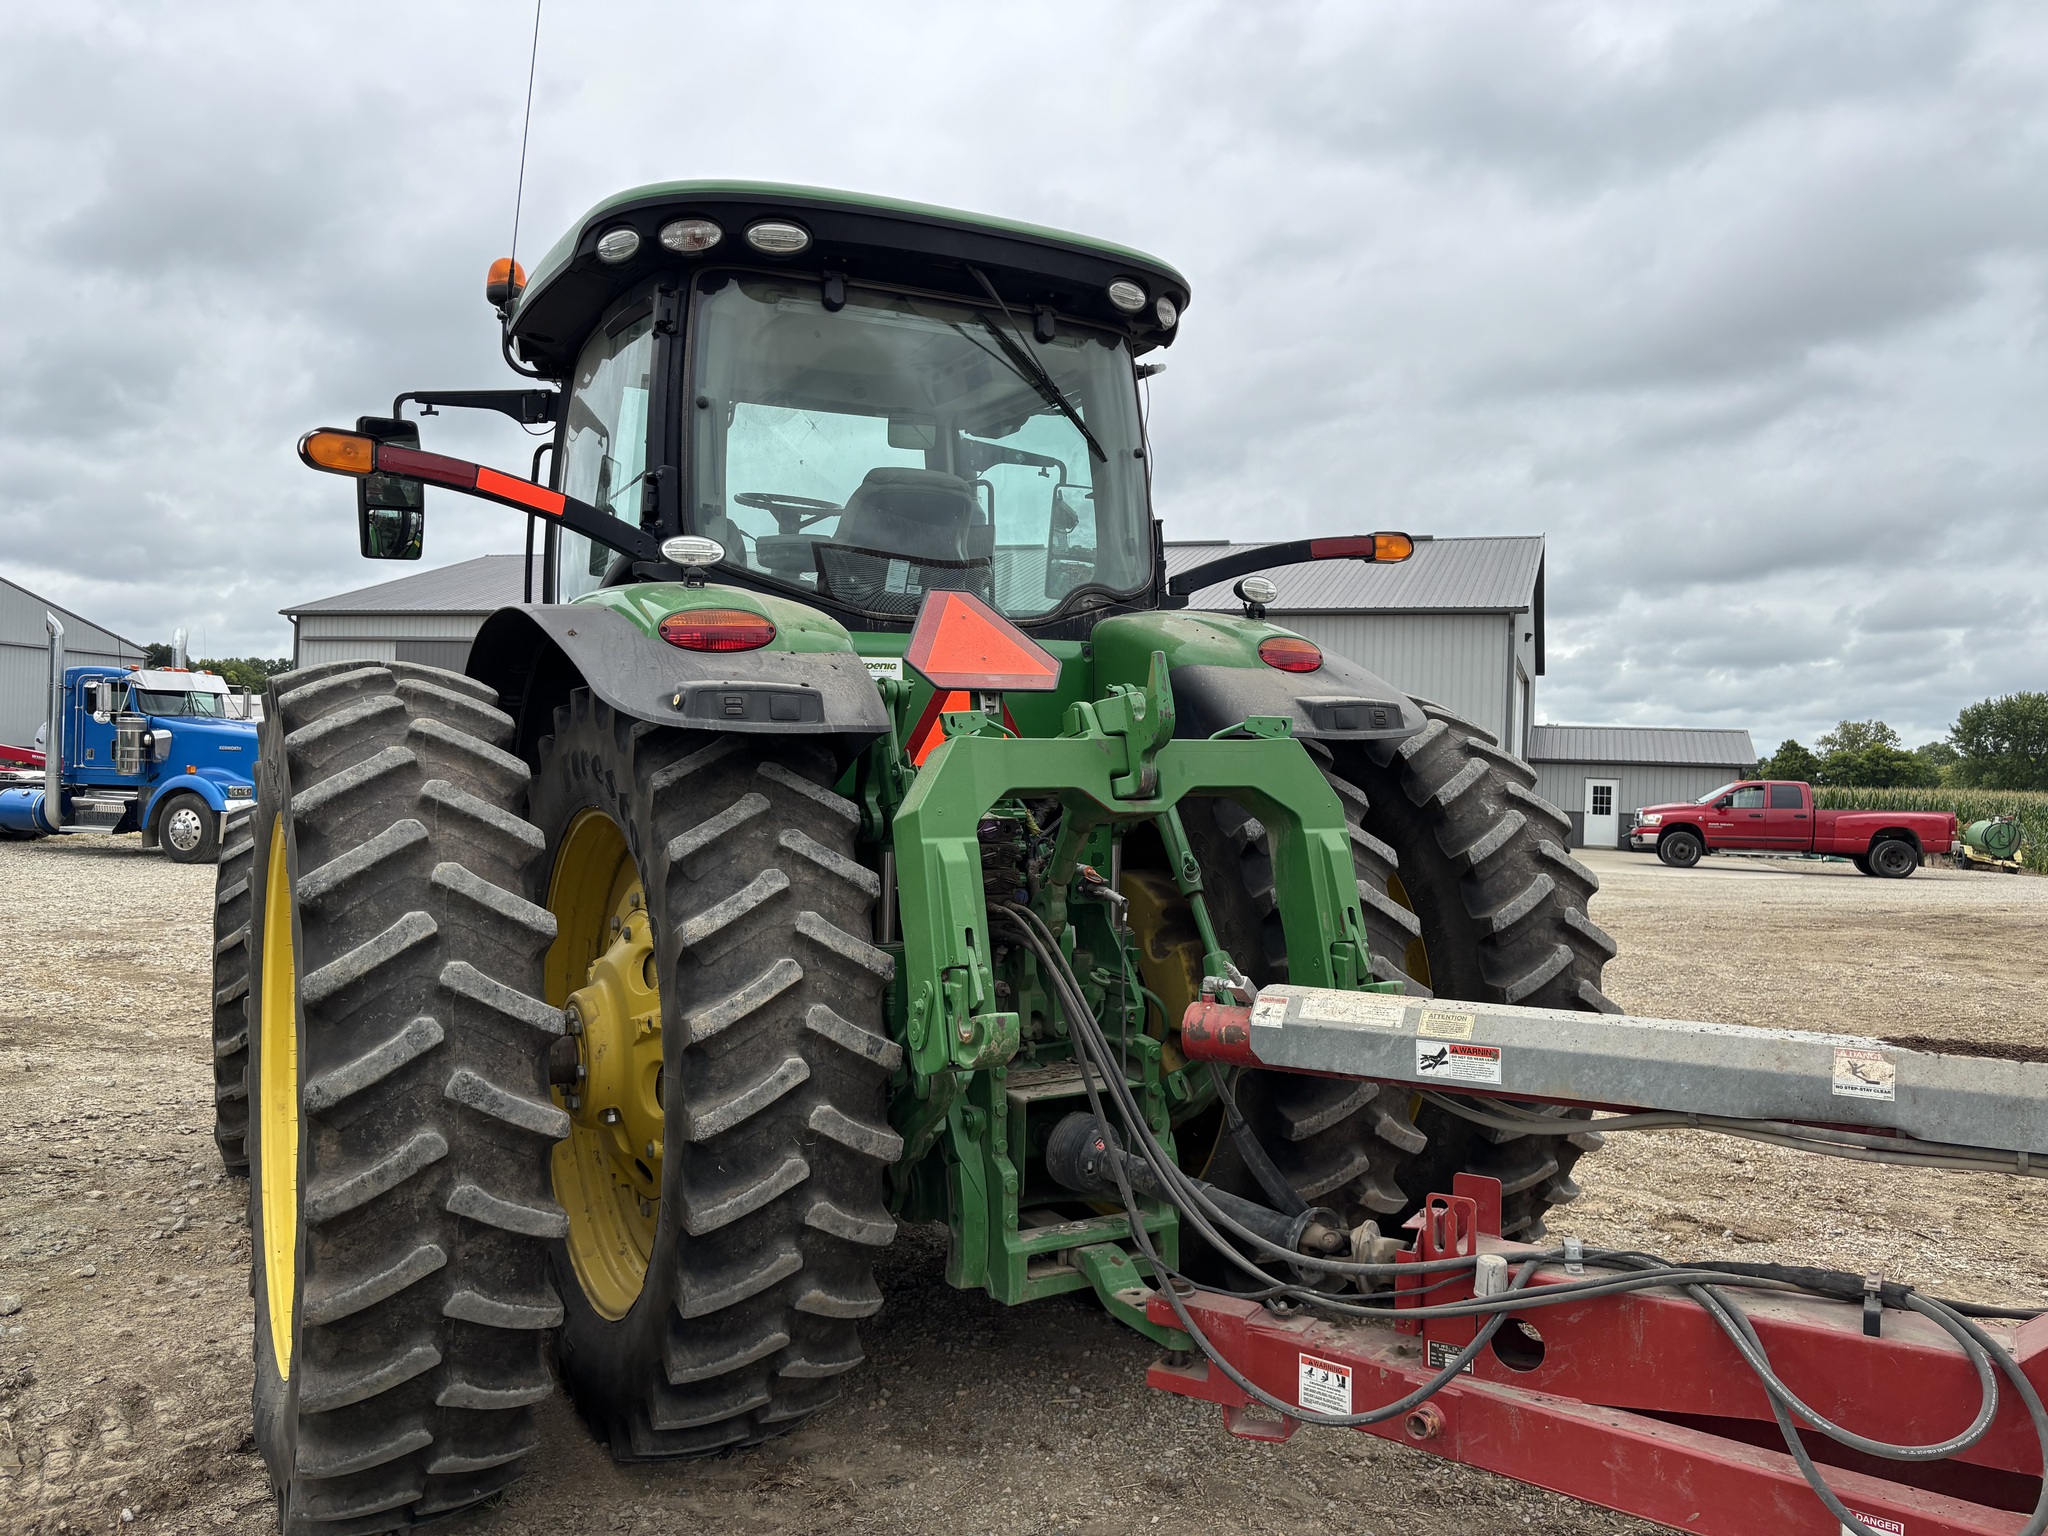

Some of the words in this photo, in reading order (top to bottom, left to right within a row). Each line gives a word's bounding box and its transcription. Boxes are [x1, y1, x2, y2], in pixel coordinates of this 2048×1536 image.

[864, 662, 897, 670] oenig
[97, 811, 120, 822] FARMS
[1428, 1013, 1468, 1021] ATTENTION
[1313, 1360, 1343, 1374] WARNING
[1855, 1513, 1899, 1533] DANGER
